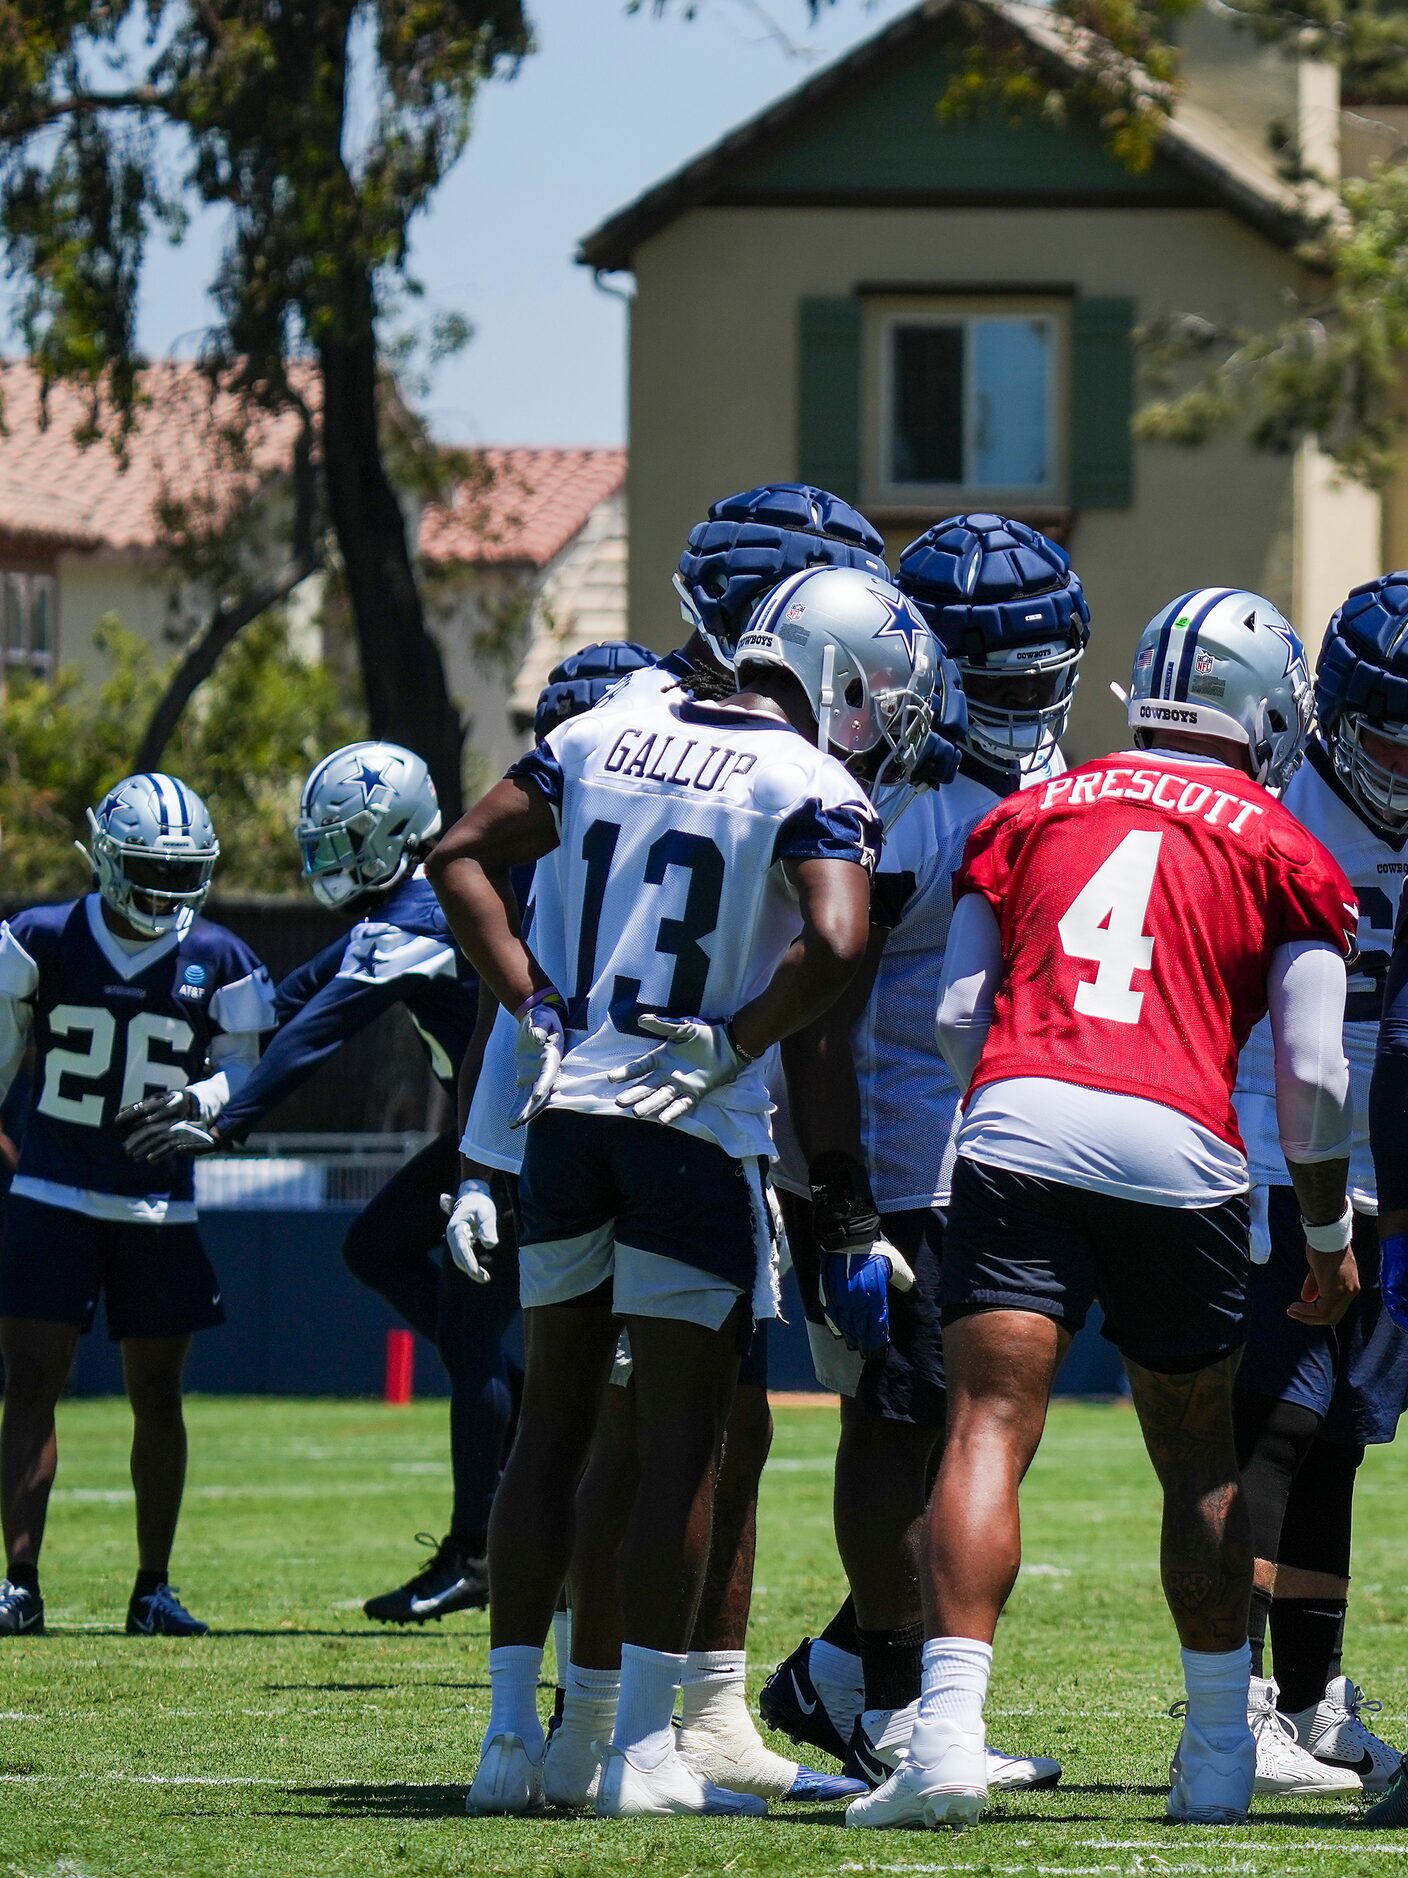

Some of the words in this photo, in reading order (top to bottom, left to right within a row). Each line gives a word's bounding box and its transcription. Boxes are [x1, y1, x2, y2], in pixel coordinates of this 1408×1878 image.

[1016, 649, 1051, 660] COWBOYS
[1197, 663, 1210, 672] NFL
[1140, 706, 1198, 724] COWBOYS
[604, 728, 758, 791] GALLUP
[1040, 769, 1263, 834] PRESCOTT
[564, 819, 725, 1041] 13
[1057, 829, 1164, 1024] 4
[178, 984, 206, 999] AT&T
[36, 1004, 195, 1129] 26
